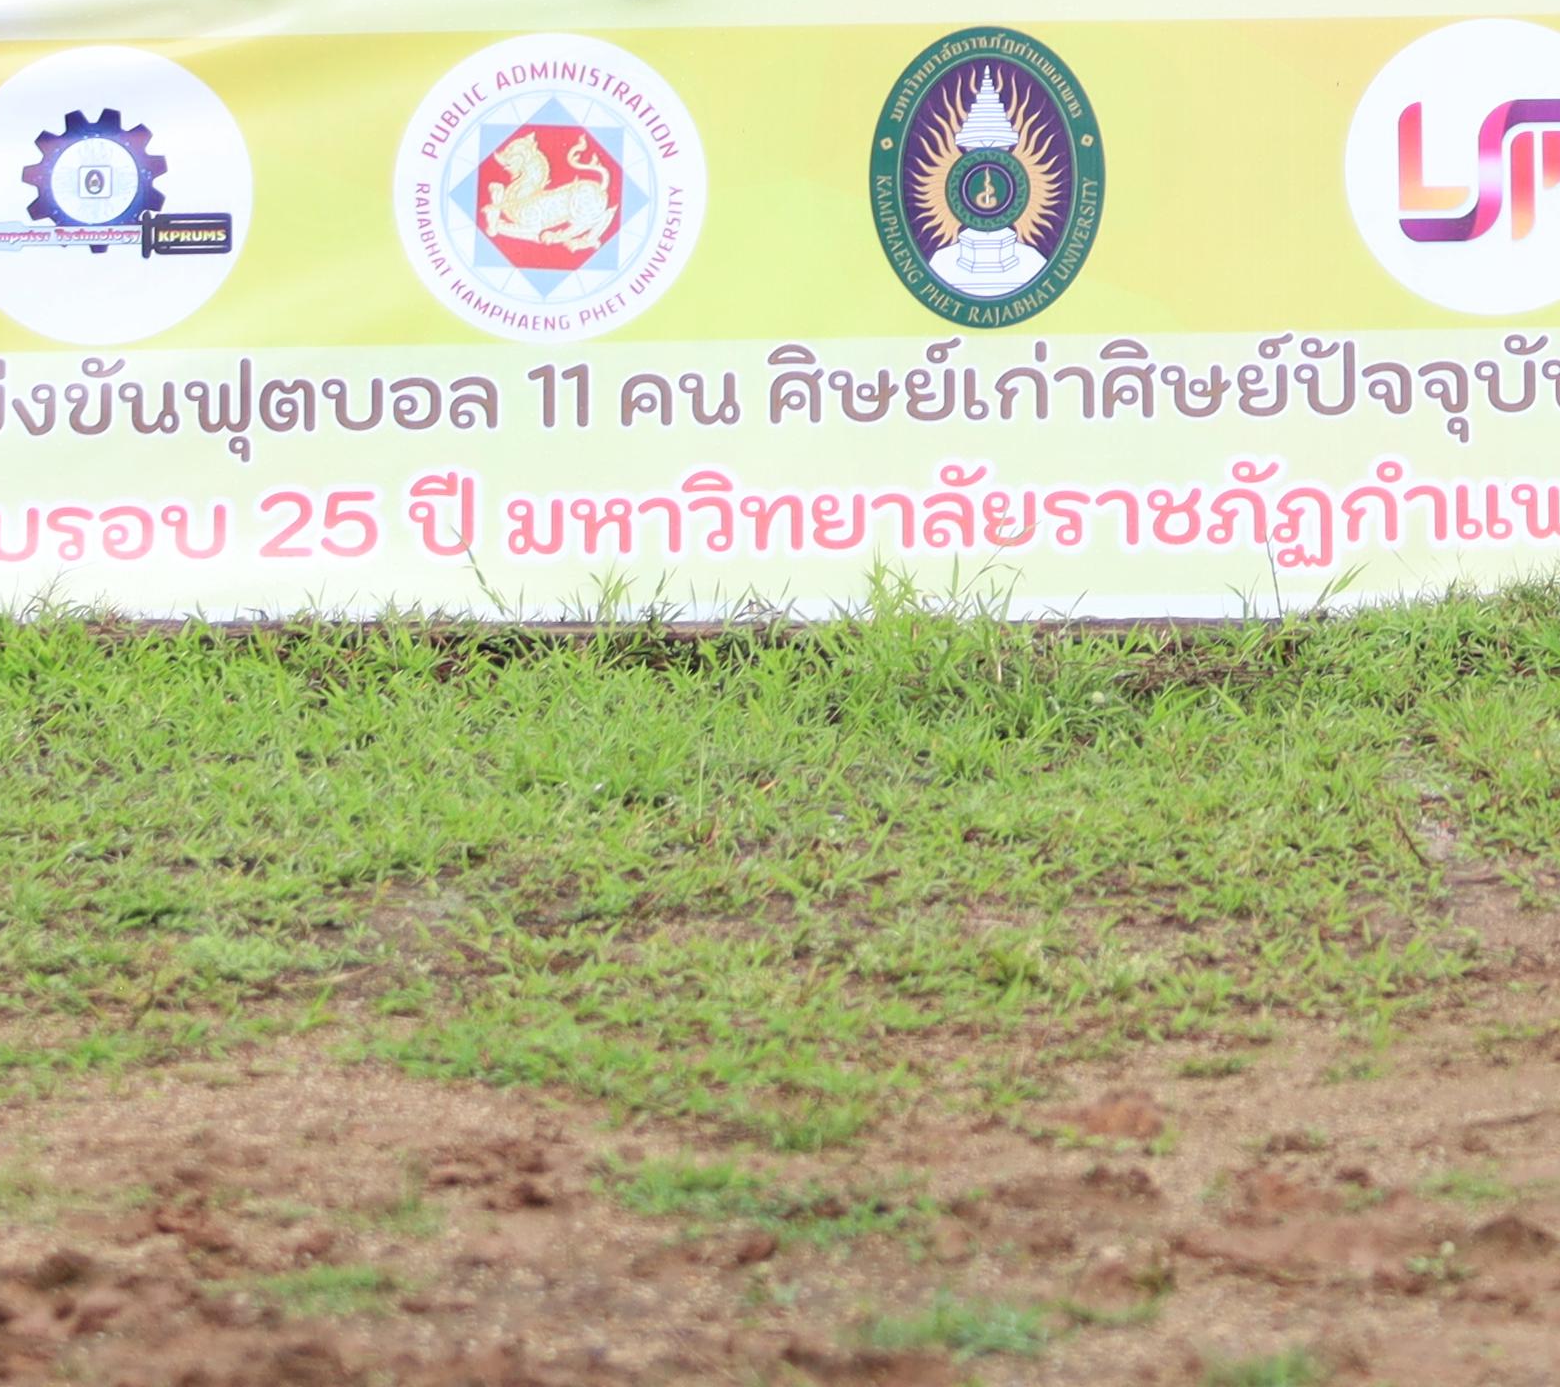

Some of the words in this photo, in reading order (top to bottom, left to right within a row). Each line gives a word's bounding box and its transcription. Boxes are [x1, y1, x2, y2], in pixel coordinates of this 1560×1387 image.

[420, 82, 488, 160] PUBLIC
[495, 60, 680, 160] ADMINISTRATION
[55, 227, 142, 244] Technology
[157, 229, 227, 243] KPRUMS
[450, 277, 571, 331] KAMPHAENG
[579, 292, 627, 326] PHET
[630, 185, 684, 296] UNIVERSITY
[876, 174, 924, 284] KAMPHAENG
[919, 281, 965, 317] PHET
[967, 279, 1057, 327] RAJABHAT
[1053, 176, 1099, 282] UNIVERSITY
[528, 362, 591, 428] 11
[620, 369, 741, 427] คน
[257, 489, 379, 560] 25
[408, 471, 474, 558] ปี
